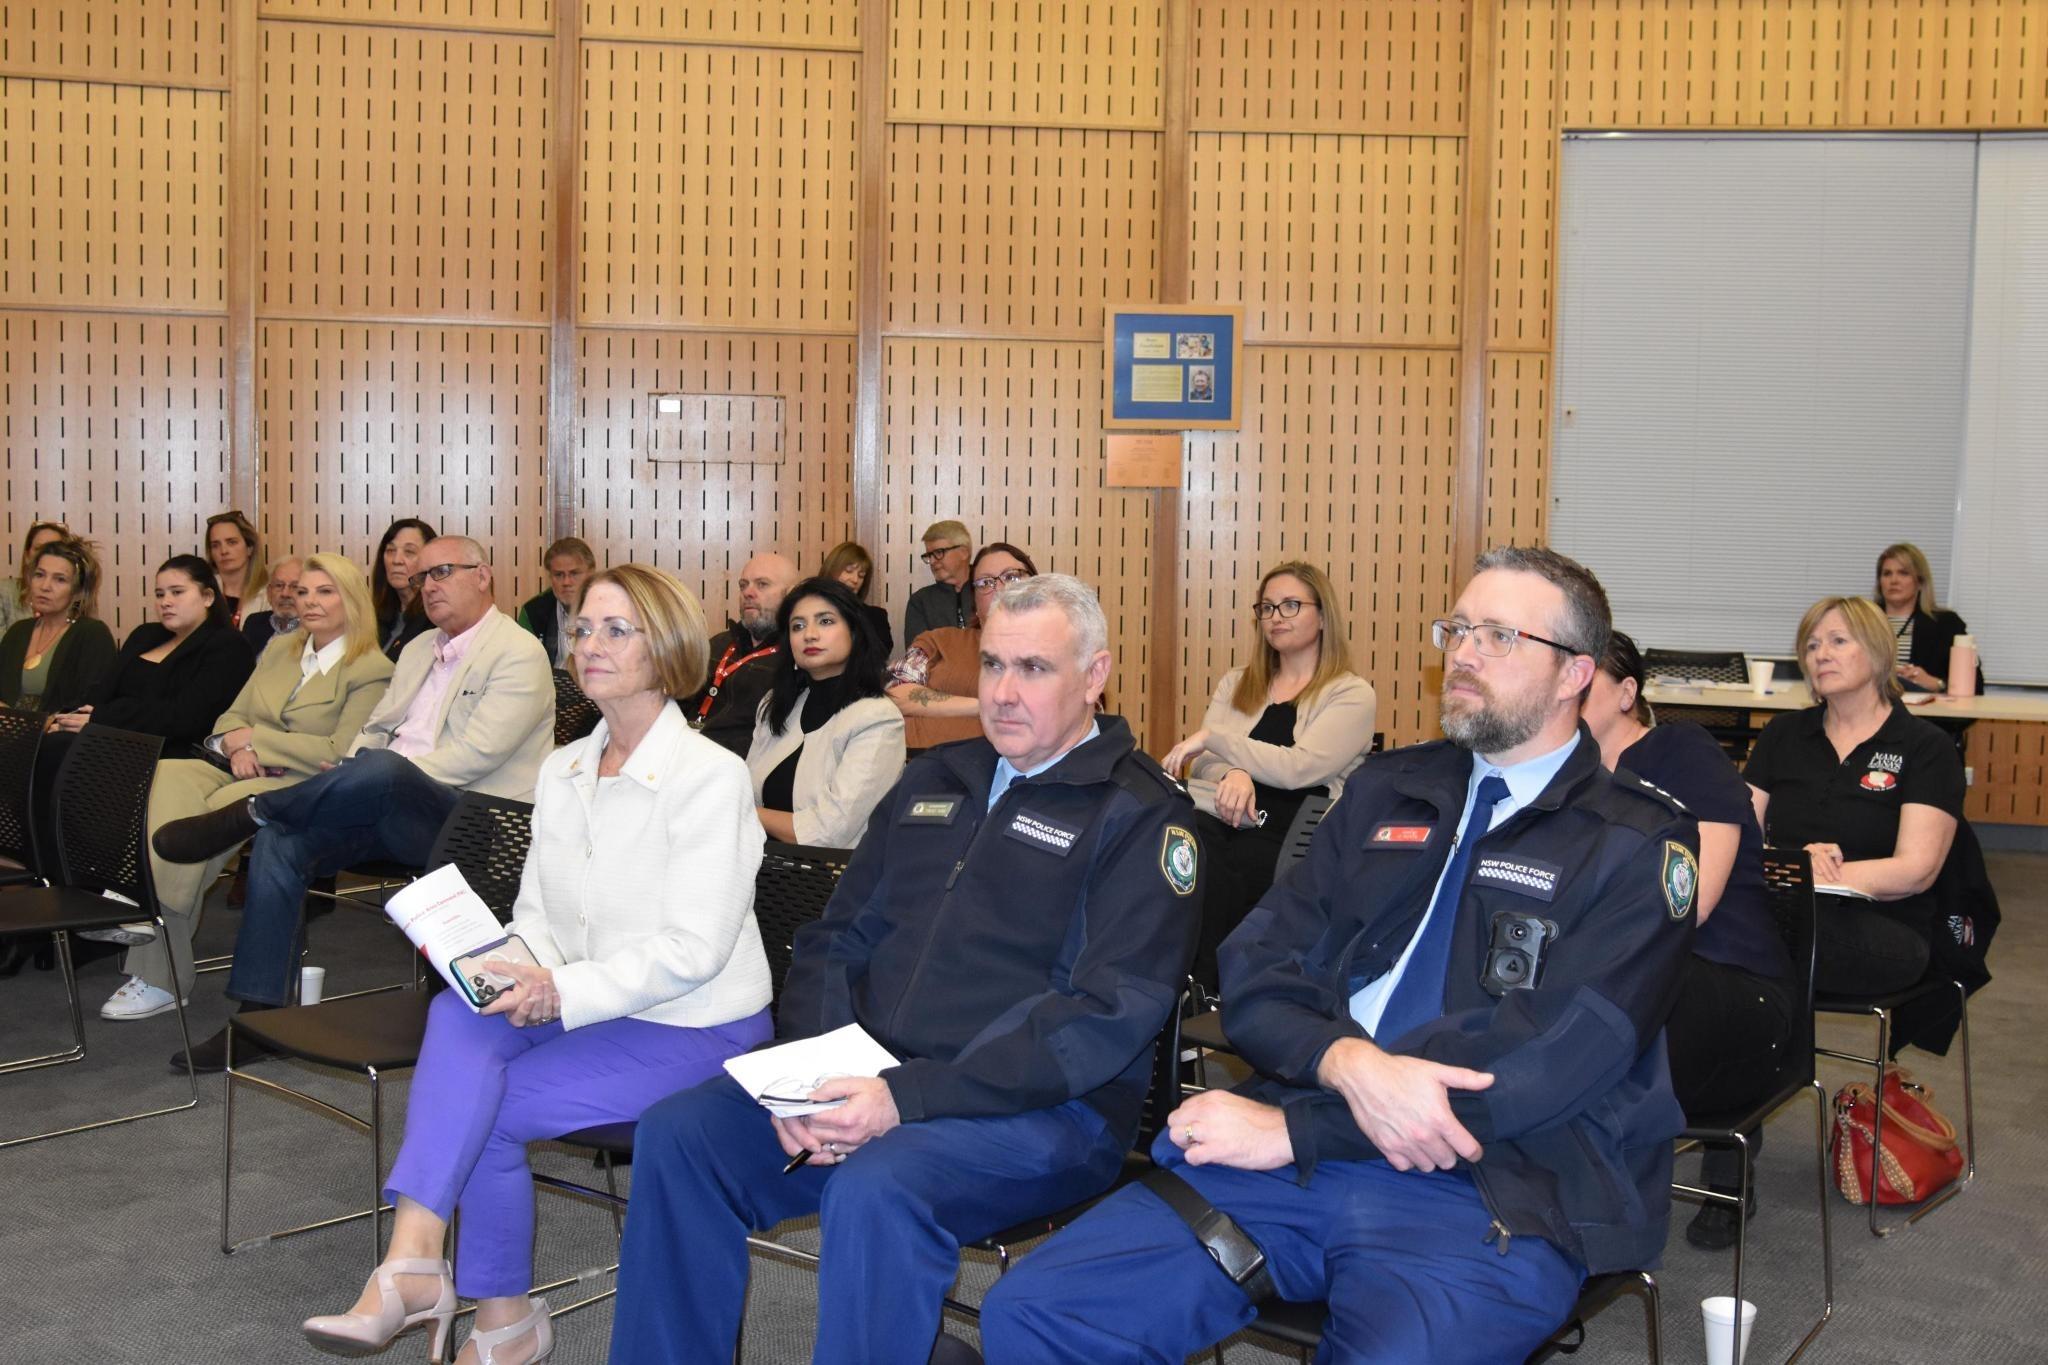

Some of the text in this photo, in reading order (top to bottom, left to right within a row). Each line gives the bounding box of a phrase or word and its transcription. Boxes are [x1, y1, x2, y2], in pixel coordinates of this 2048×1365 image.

[1872, 752, 1903, 764] MAMA
[1016, 814, 1075, 841] NSW POLICE FORCE
[1481, 859, 1555, 881] NSW POLICE FORCE
